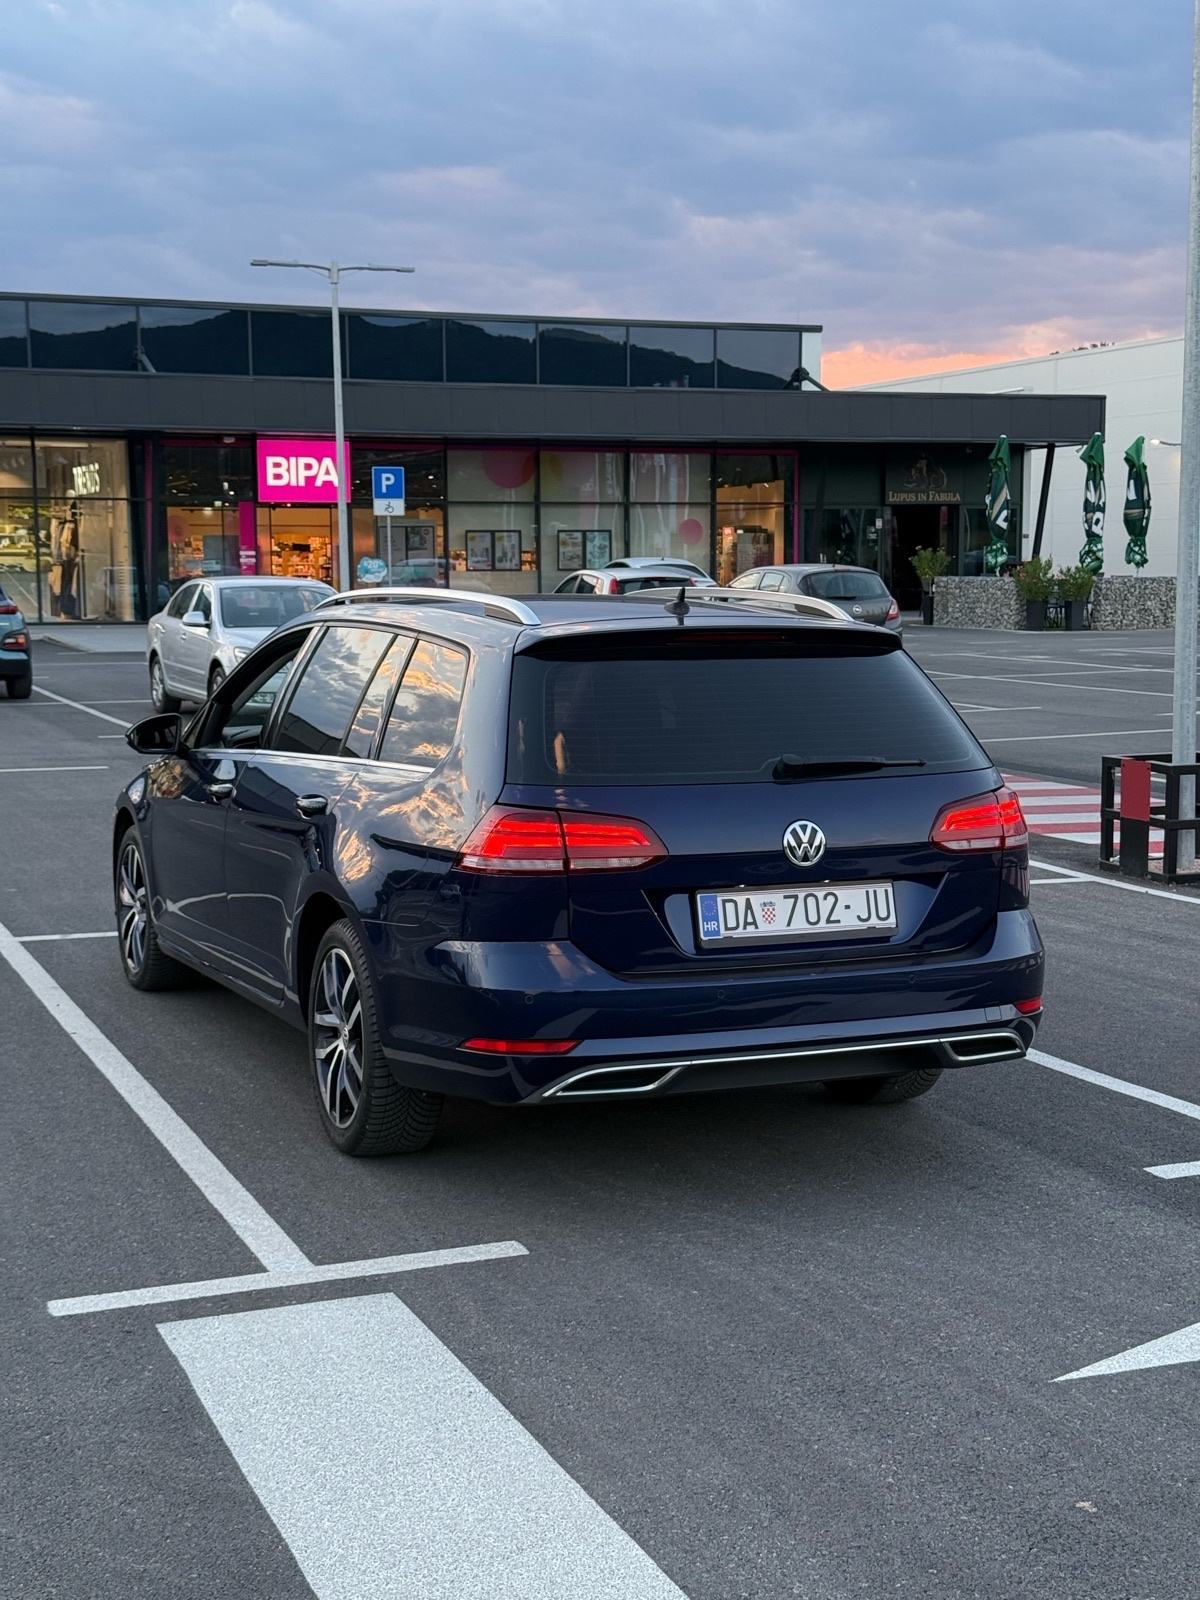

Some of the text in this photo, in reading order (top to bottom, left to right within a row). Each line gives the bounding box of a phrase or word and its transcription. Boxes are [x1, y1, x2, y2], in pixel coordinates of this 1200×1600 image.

[266, 456, 339, 487] BIPA
[381, 473, 395, 493] P
[704, 921, 718, 931] HR
[721, 897, 759, 931] DA
